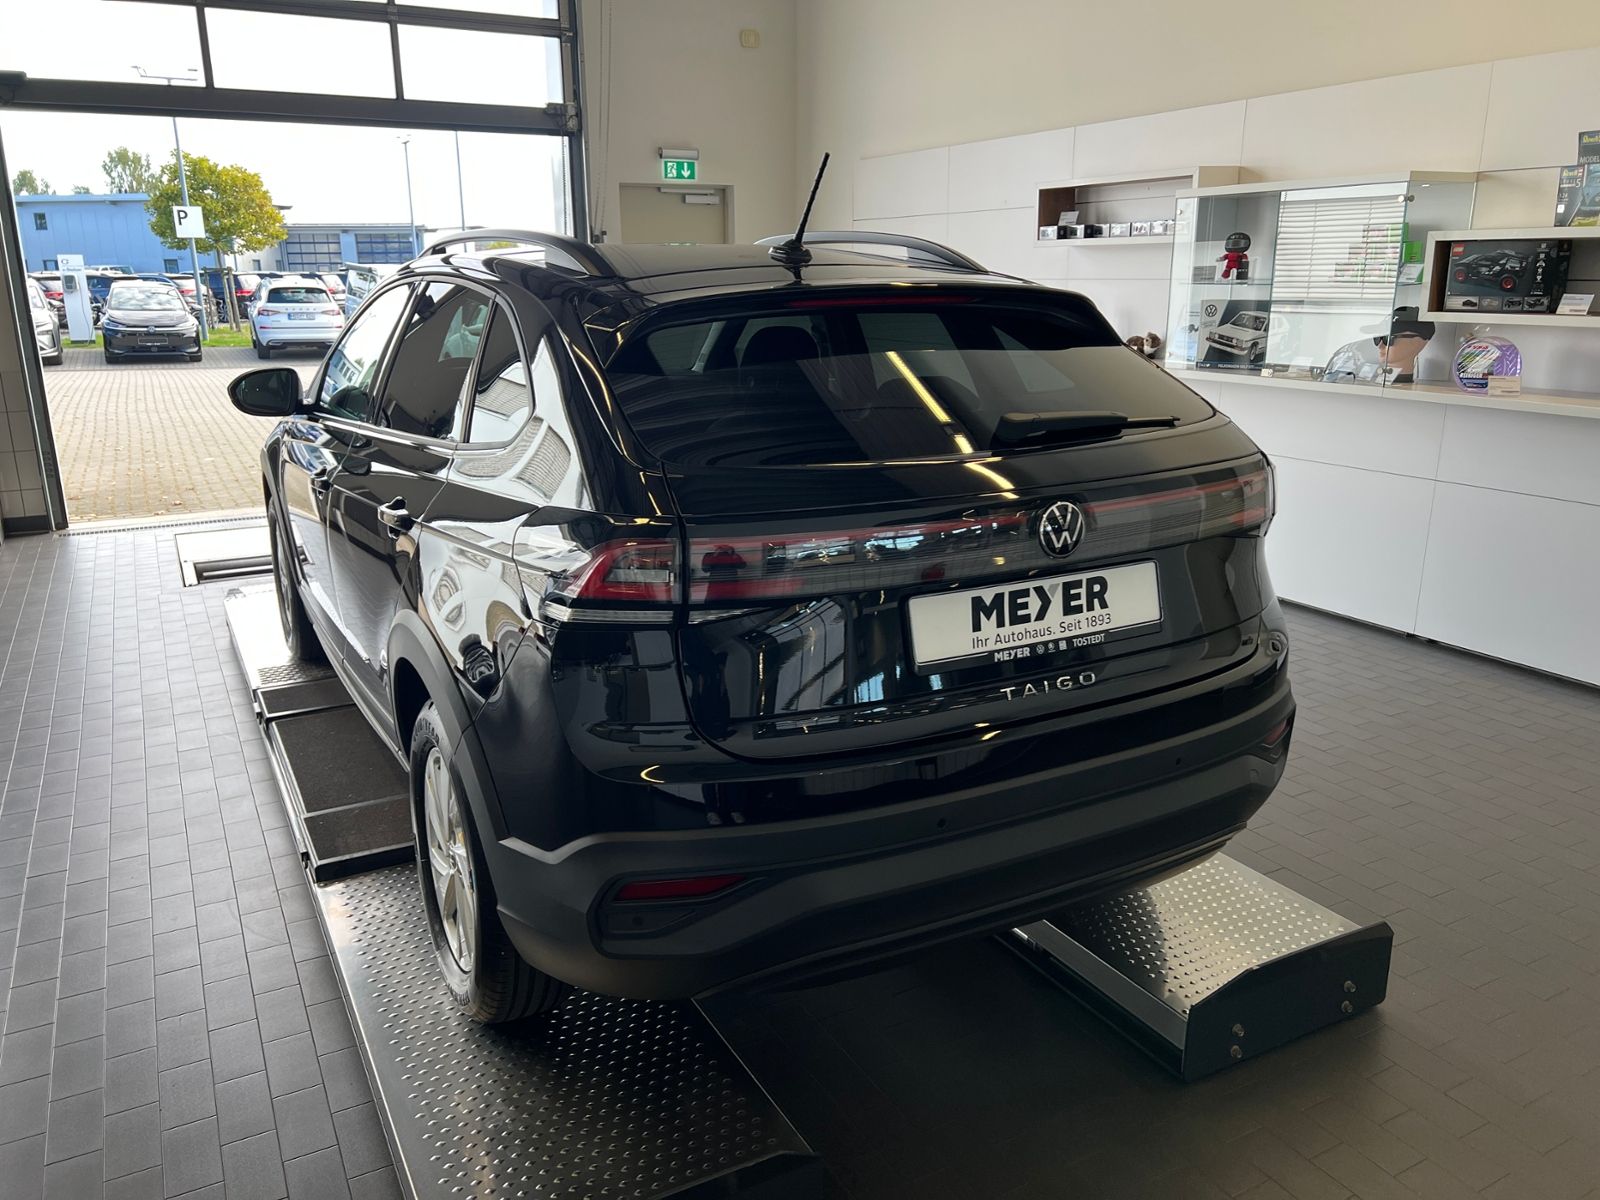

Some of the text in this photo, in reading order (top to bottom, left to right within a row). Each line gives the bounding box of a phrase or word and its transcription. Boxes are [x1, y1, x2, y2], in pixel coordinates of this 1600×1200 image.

[177, 209, 189, 226] P
[971, 575, 1109, 633] MEYER
[972, 613, 1112, 649] Ihr Autohaus. Seit 1893
[994, 633, 1106, 662] MEYER TOSTEDT
[1000, 671, 1096, 701] TAIGO
